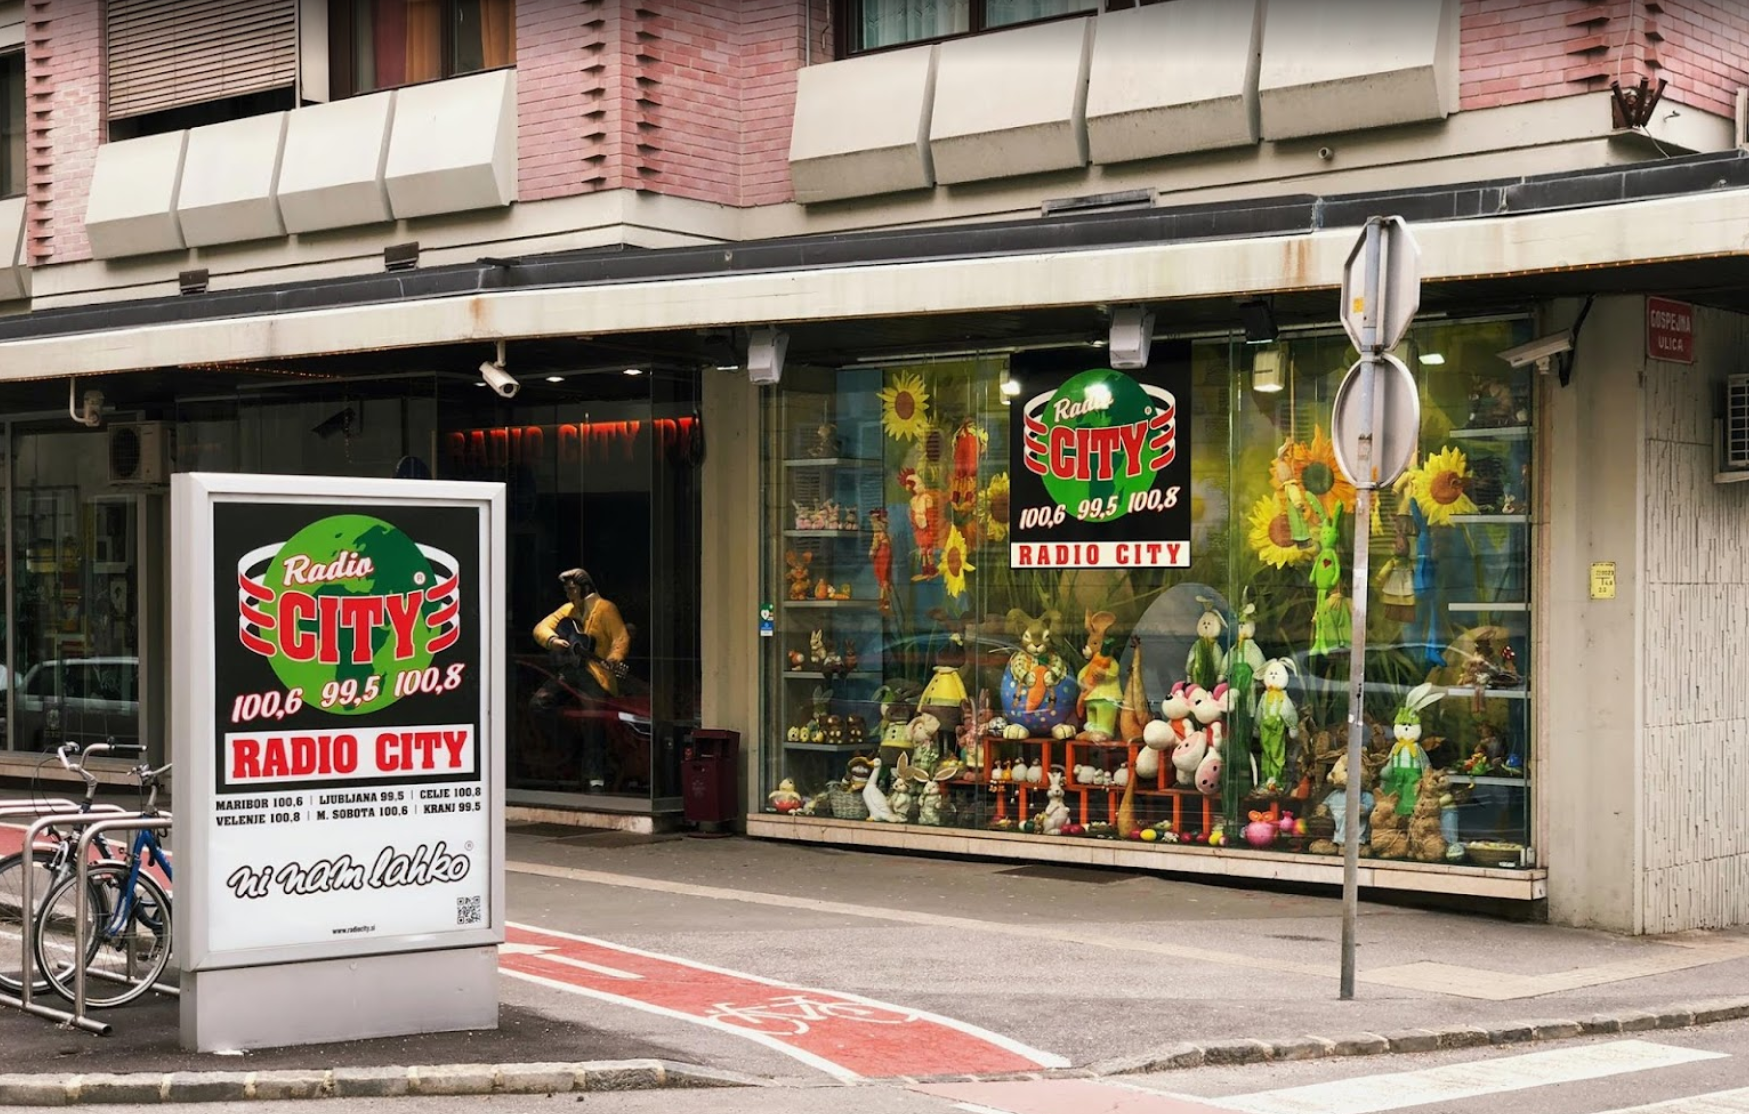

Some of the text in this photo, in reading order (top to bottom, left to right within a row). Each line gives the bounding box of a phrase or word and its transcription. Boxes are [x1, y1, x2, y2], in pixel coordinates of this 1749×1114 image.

[1658, 336, 1684, 352] ULICA
[557, 419, 640, 464] CITY
[1050, 419, 1149, 482] CITY
[1019, 486, 1181, 530] 100,6 99,5 100,8
[283, 551, 374, 587] Radio
[1019, 543, 1181, 566] RADIO CITY
[278, 589, 424, 665] CITY
[231, 663, 466, 724] 100,6 99,5 100,8
[232, 730, 468, 779] RADIO CITY
[215, 798, 269, 812] MARIBOR
[319, 792, 378, 806] LJUBLJANA
[420, 788, 451, 800] CELJE
[216, 814, 267, 827] VELENJE
[316, 810, 329, 821] M.
[332, 808, 376, 820] SOBOTA
[423, 803, 456, 815] KRANJ
[226, 840, 471, 899] ni nam lahko
